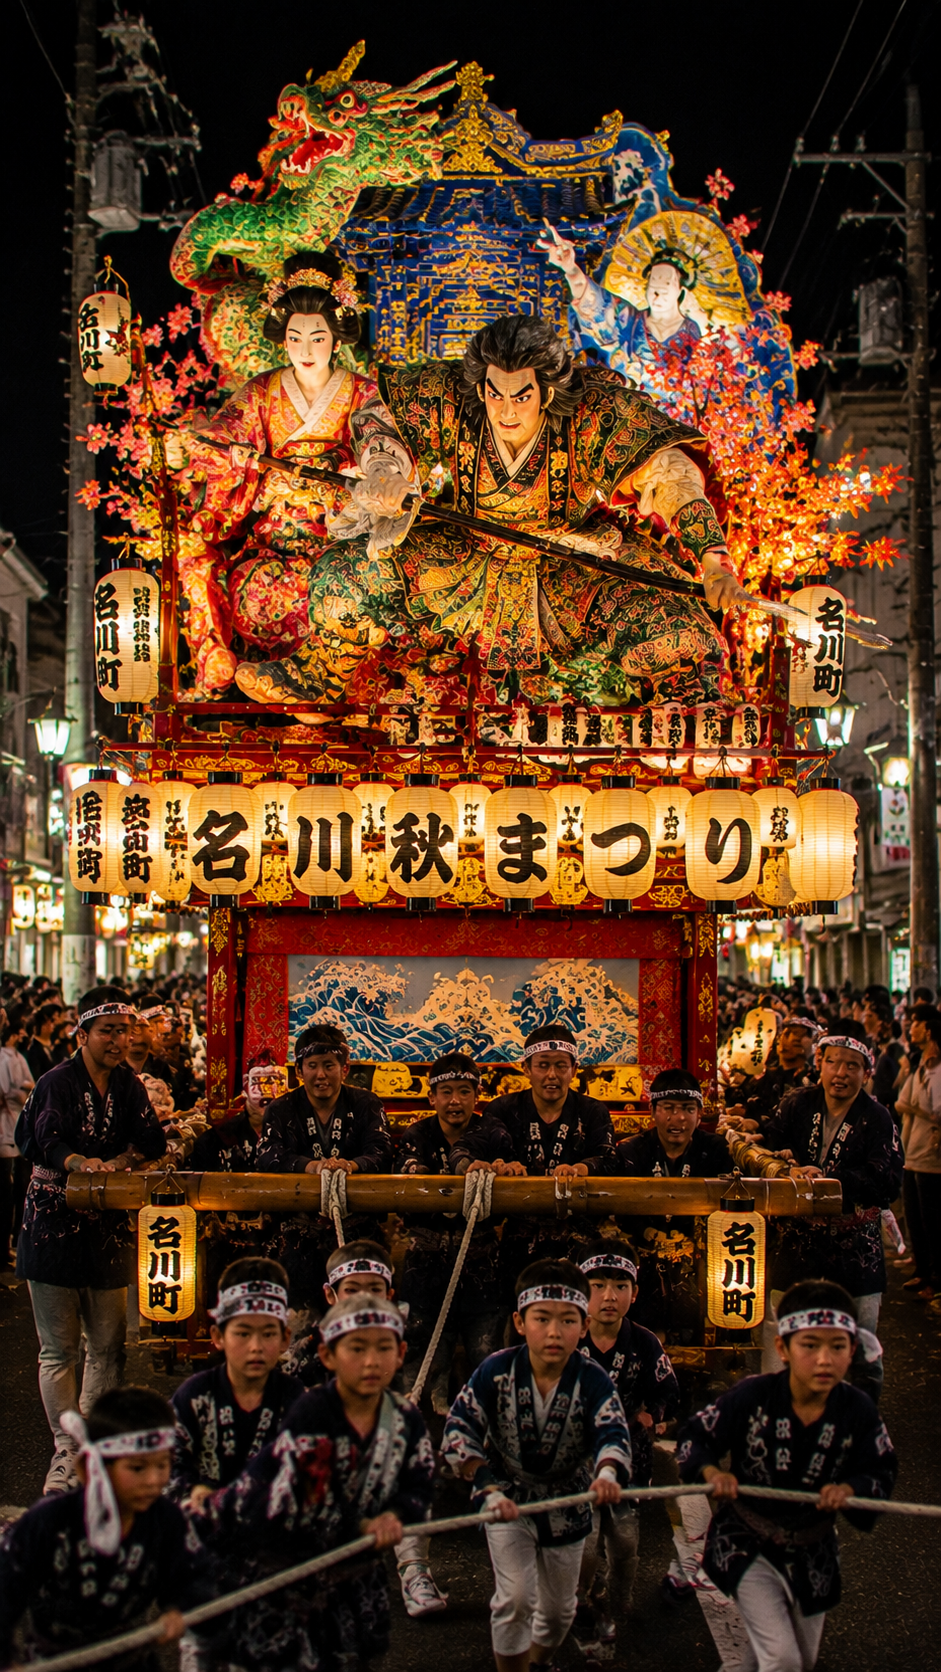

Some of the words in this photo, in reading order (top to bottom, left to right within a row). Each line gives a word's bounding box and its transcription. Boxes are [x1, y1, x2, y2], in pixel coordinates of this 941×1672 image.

[95, 582, 123, 692] 名川町
[813, 596, 844, 698] 名川町
[192, 809, 754, 885] 名川秋まつり
[147, 1216, 182, 1315] 名川町
[721, 1222, 756, 1323] 名川町
